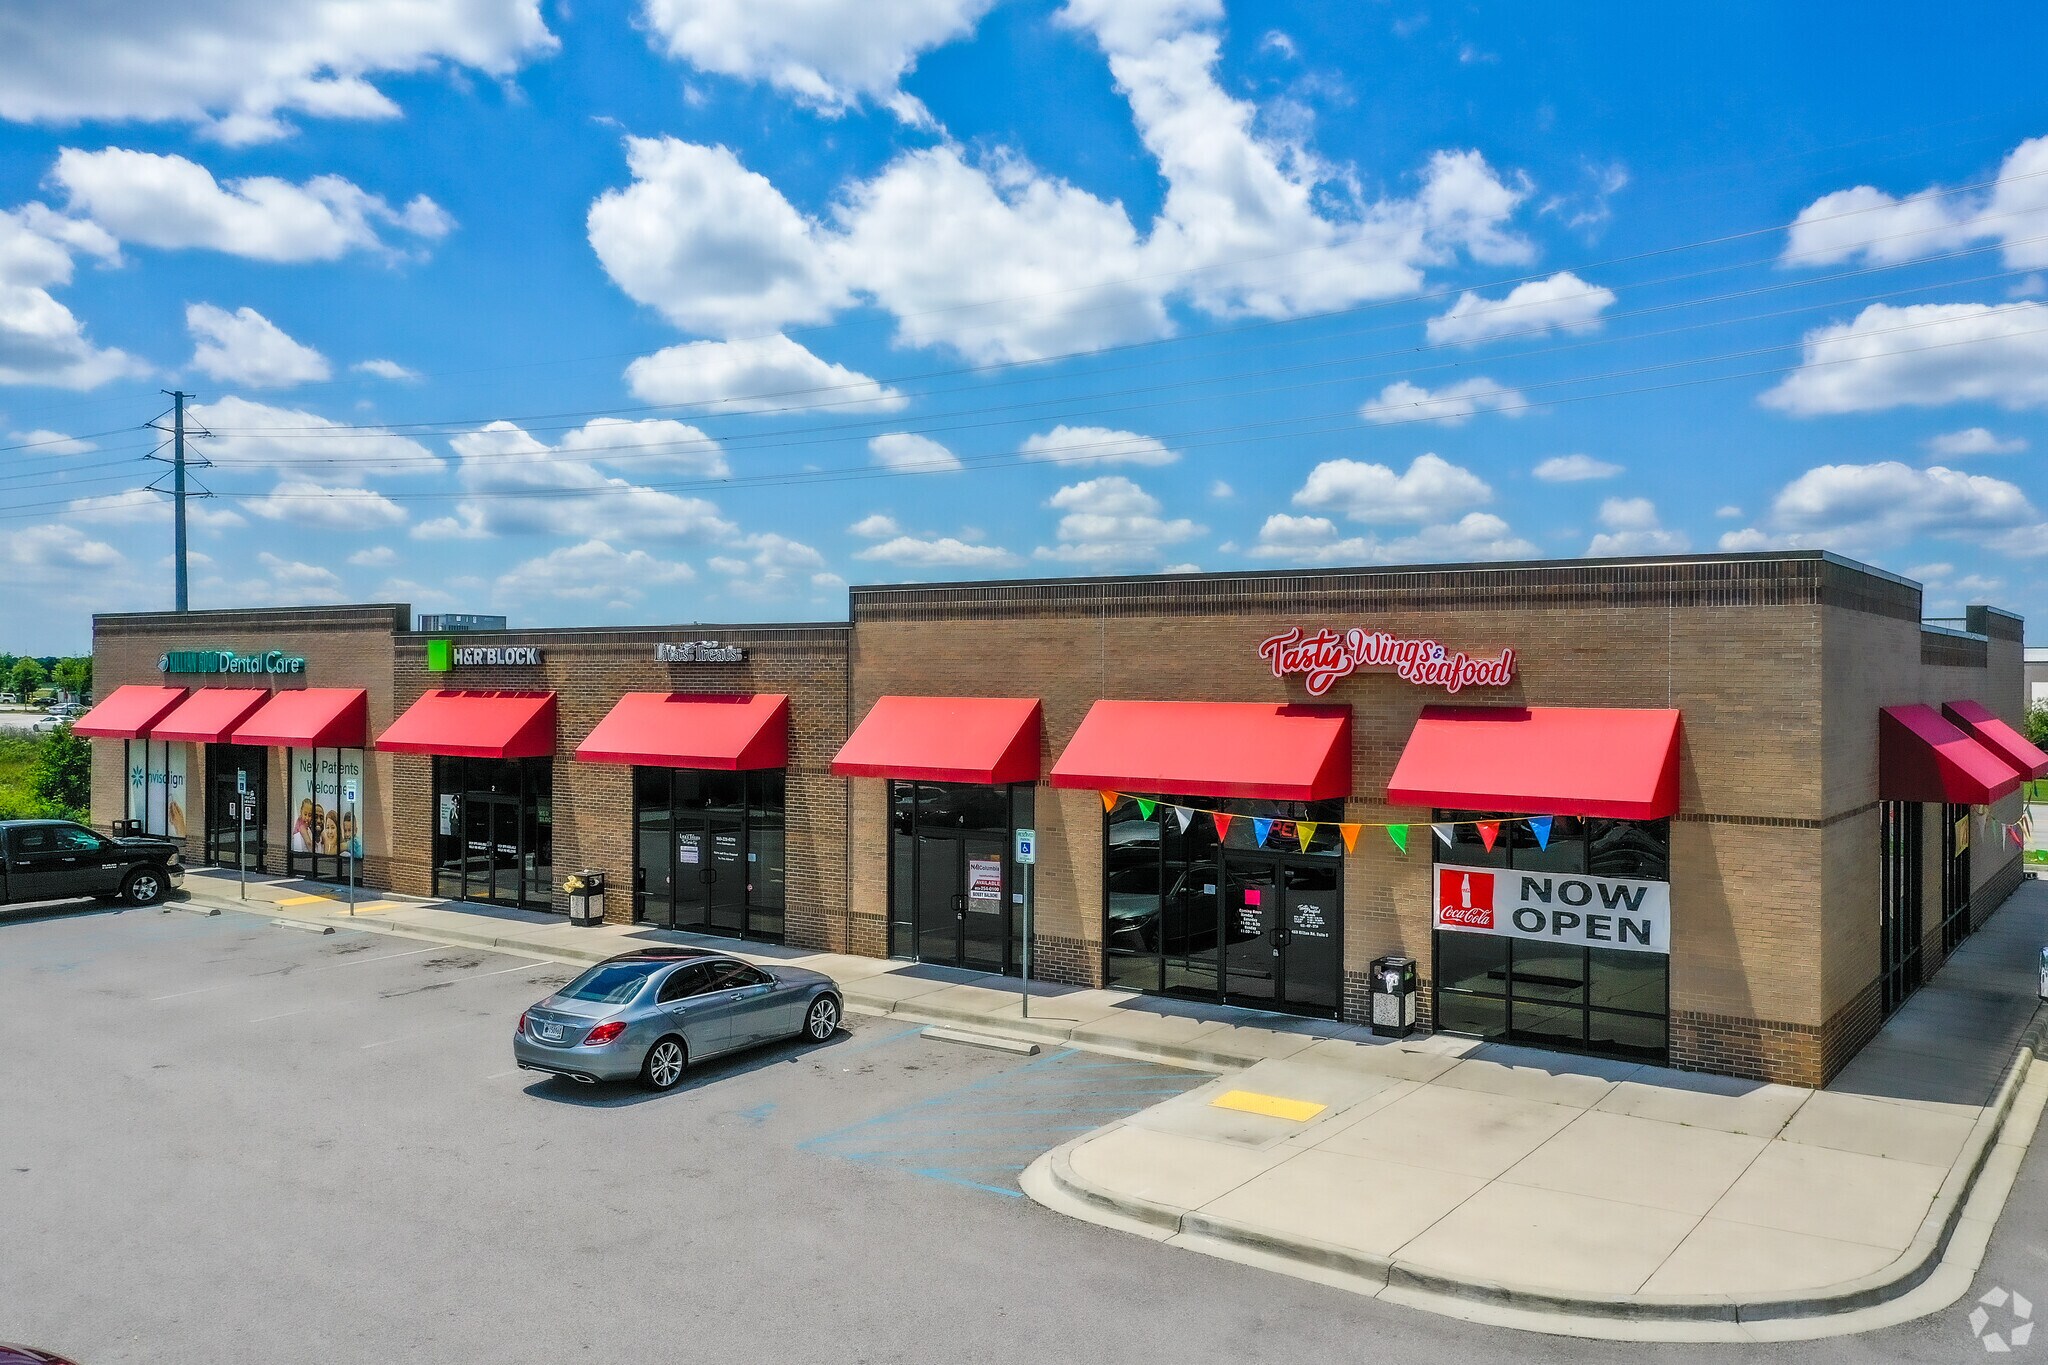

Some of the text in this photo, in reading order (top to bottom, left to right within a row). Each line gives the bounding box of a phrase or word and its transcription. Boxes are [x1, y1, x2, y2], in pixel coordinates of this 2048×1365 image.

[219, 651, 263, 673] Dental
[266, 650, 299, 673] Care
[453, 647, 537, 665] H&R BLOCK
[1260, 627, 1354, 695] Tasty
[1347, 628, 1433, 678] Wings
[1413, 648, 1514, 693] seafood
[322, 760, 359, 775] Patents
[1520, 876, 1648, 912] NOW
[1440, 905, 1493, 925] Coca-Cola
[1512, 907, 1651, 946] OPEN
